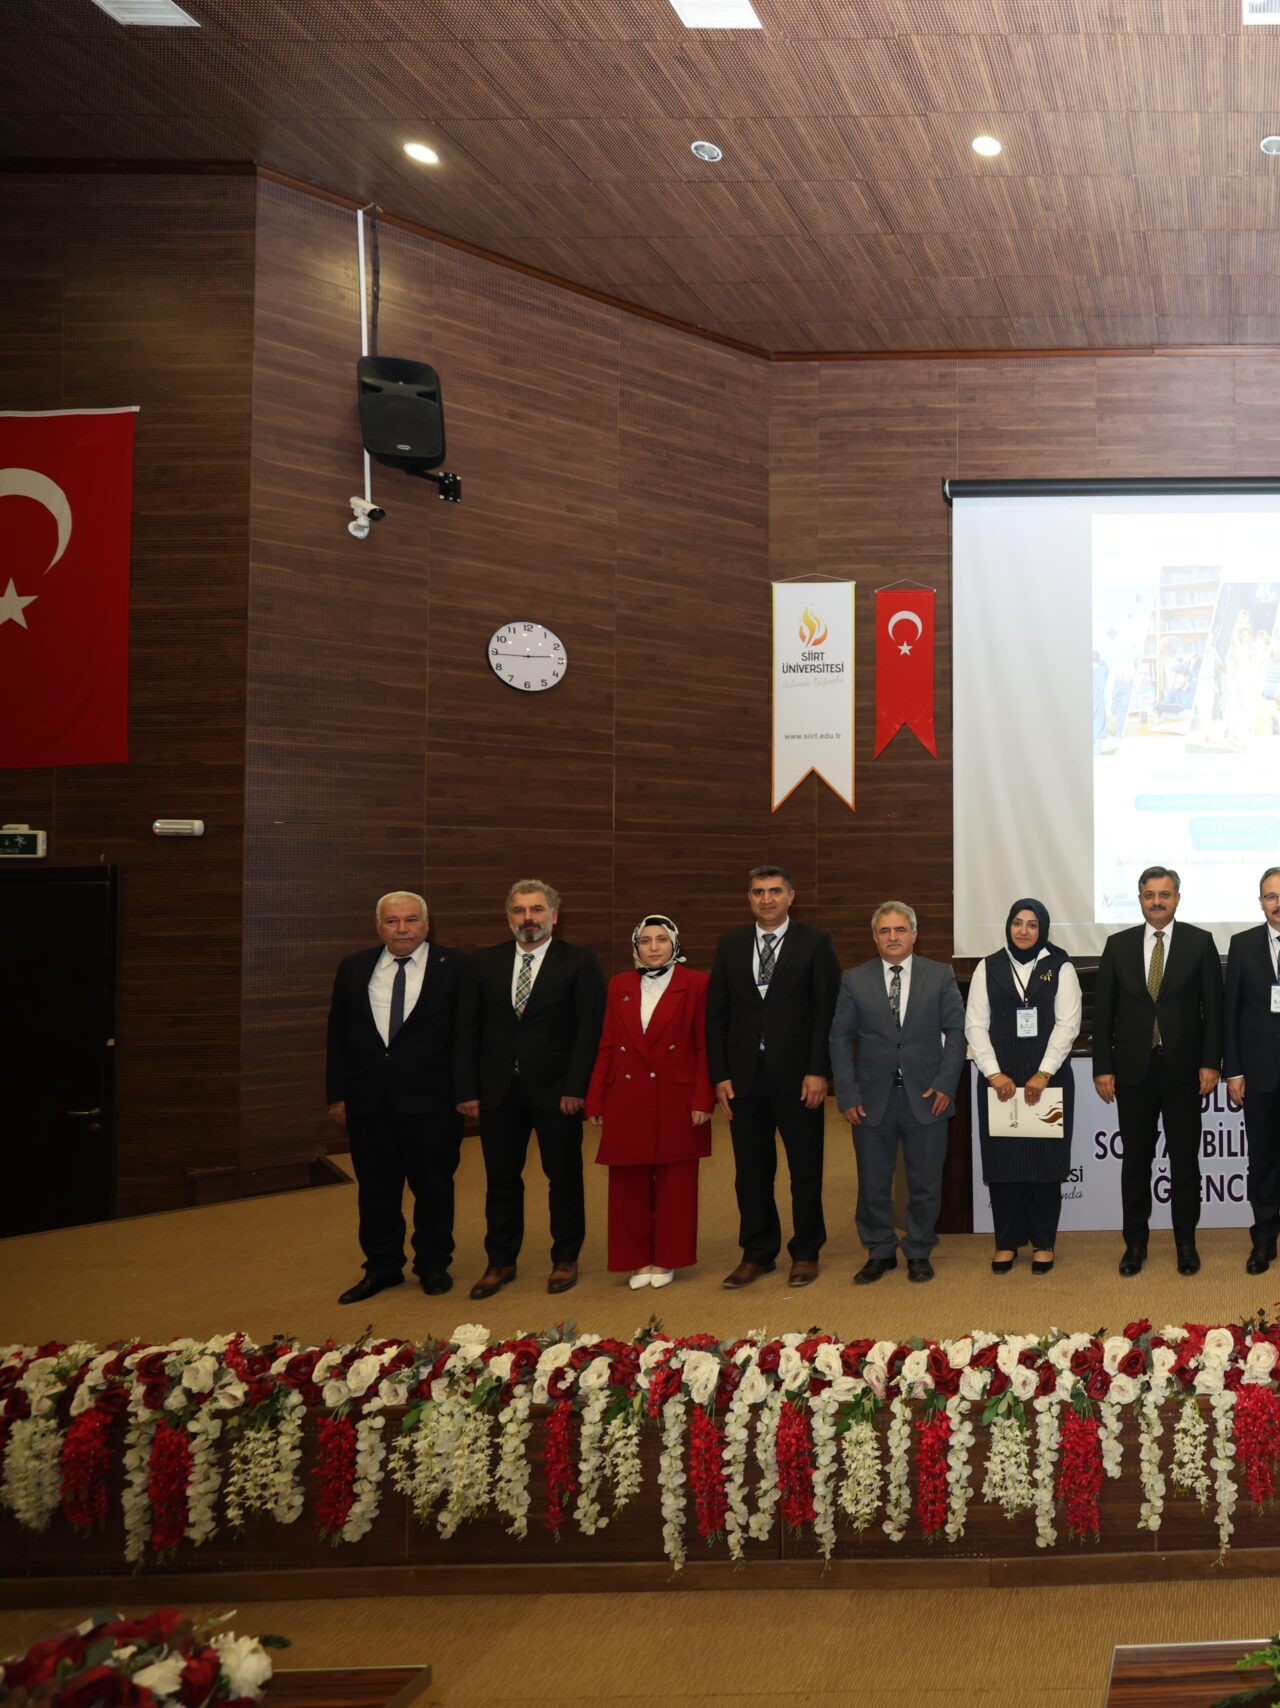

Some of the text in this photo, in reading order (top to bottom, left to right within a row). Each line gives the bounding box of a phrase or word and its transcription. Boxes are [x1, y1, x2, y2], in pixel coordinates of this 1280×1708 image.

[507, 626, 516, 634] 11
[523, 624, 534, 632] 12
[496, 635, 507, 643] 10
[553, 643, 560, 651] 2
[491, 648, 499, 656] 9
[801, 650, 825, 662] SİİRT
[557, 657, 564, 665] 3
[495, 663, 503, 671] 8
[782, 662, 844, 674] ÜNİVERSİTESİ
[508, 674, 514, 682] 7
[552, 670, 559, 678] 4
[523, 681, 531, 689] 6
[540, 679, 548, 687] 5
[784, 732, 842, 741] www.siirt.edu.tr
